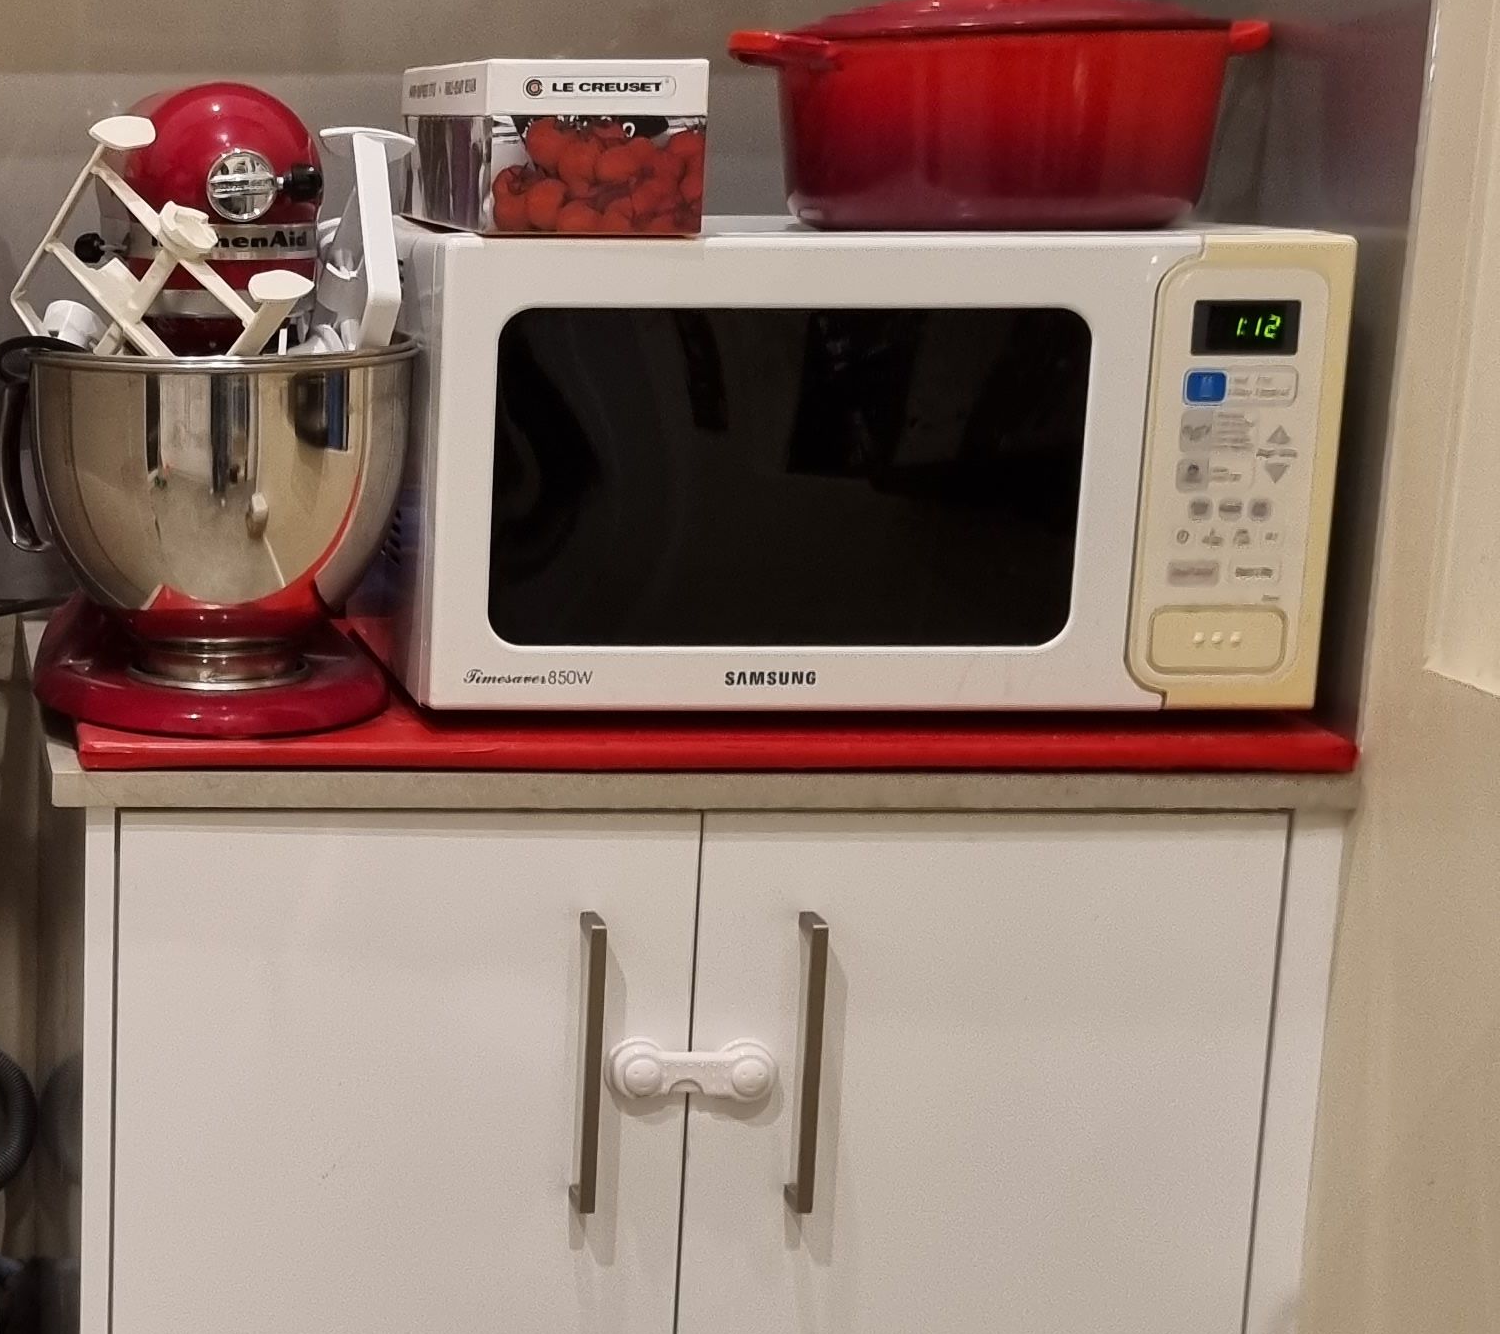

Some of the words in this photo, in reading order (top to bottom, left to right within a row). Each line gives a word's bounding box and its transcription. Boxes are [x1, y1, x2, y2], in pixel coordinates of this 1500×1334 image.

[552, 82, 573, 92] LE
[578, 82, 662, 93] CREUSET
[1236, 314, 1281, 339] 1:12
[463, 668, 547, 685] Timesaver
[548, 670, 593, 685] 850W
[724, 671, 817, 686] SAMSUNG
